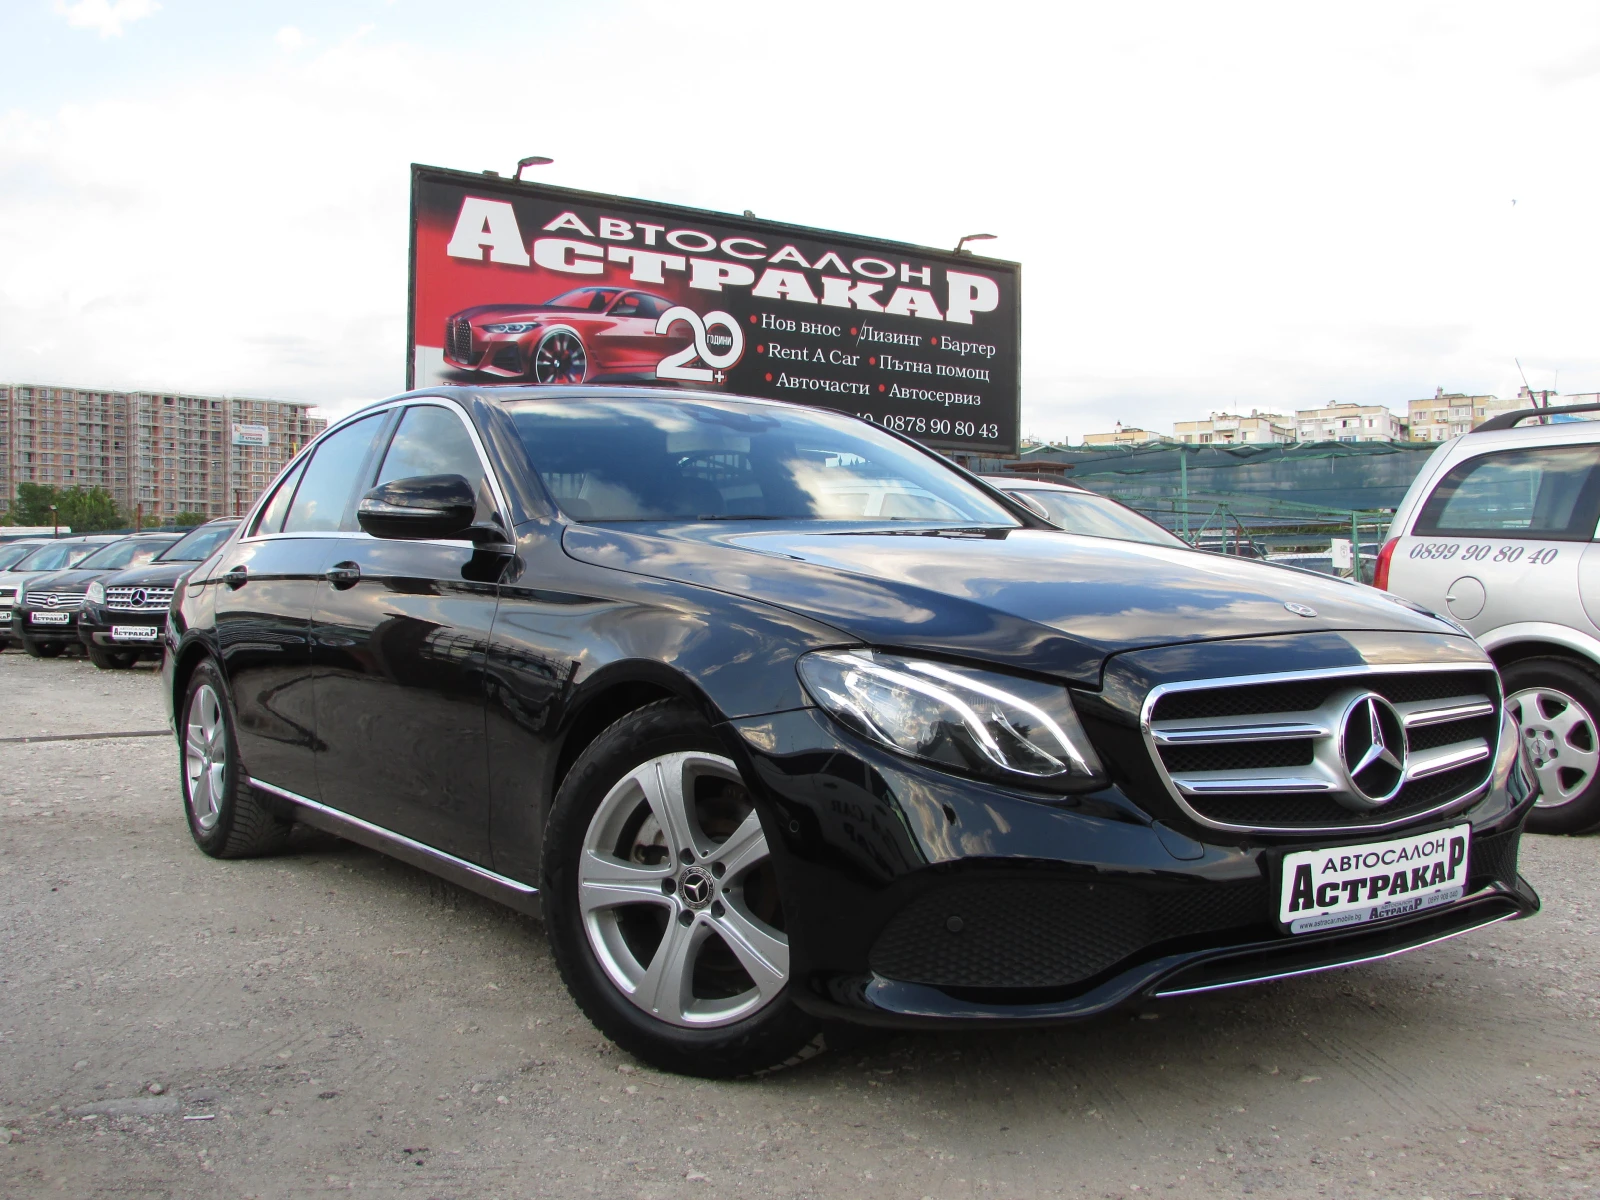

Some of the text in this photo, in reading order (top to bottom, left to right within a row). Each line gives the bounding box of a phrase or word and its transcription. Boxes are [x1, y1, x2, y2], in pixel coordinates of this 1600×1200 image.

[542, 212, 931, 286] АВТОСАЛОН
[761, 313, 841, 337] Нов внос
[860, 326, 922, 347] Лизинг
[706, 333, 732, 347] ГОДИНИ
[940, 336, 996, 359] Бартер
[768, 343, 861, 367] Rent A Car
[879, 355, 990, 382] Пътна помощ
[776, 373, 871, 395] Авточасти
[888, 384, 982, 407] Автосервиз
[883, 414, 926, 433] 0878
[929, 419, 951, 435] 90
[954, 421, 975, 437] 80
[978, 423, 999, 439] 43
[1409, 543, 1559, 565] 0899 90 80 40
[1321, 838, 1446, 875] АВТОСАЛОН
